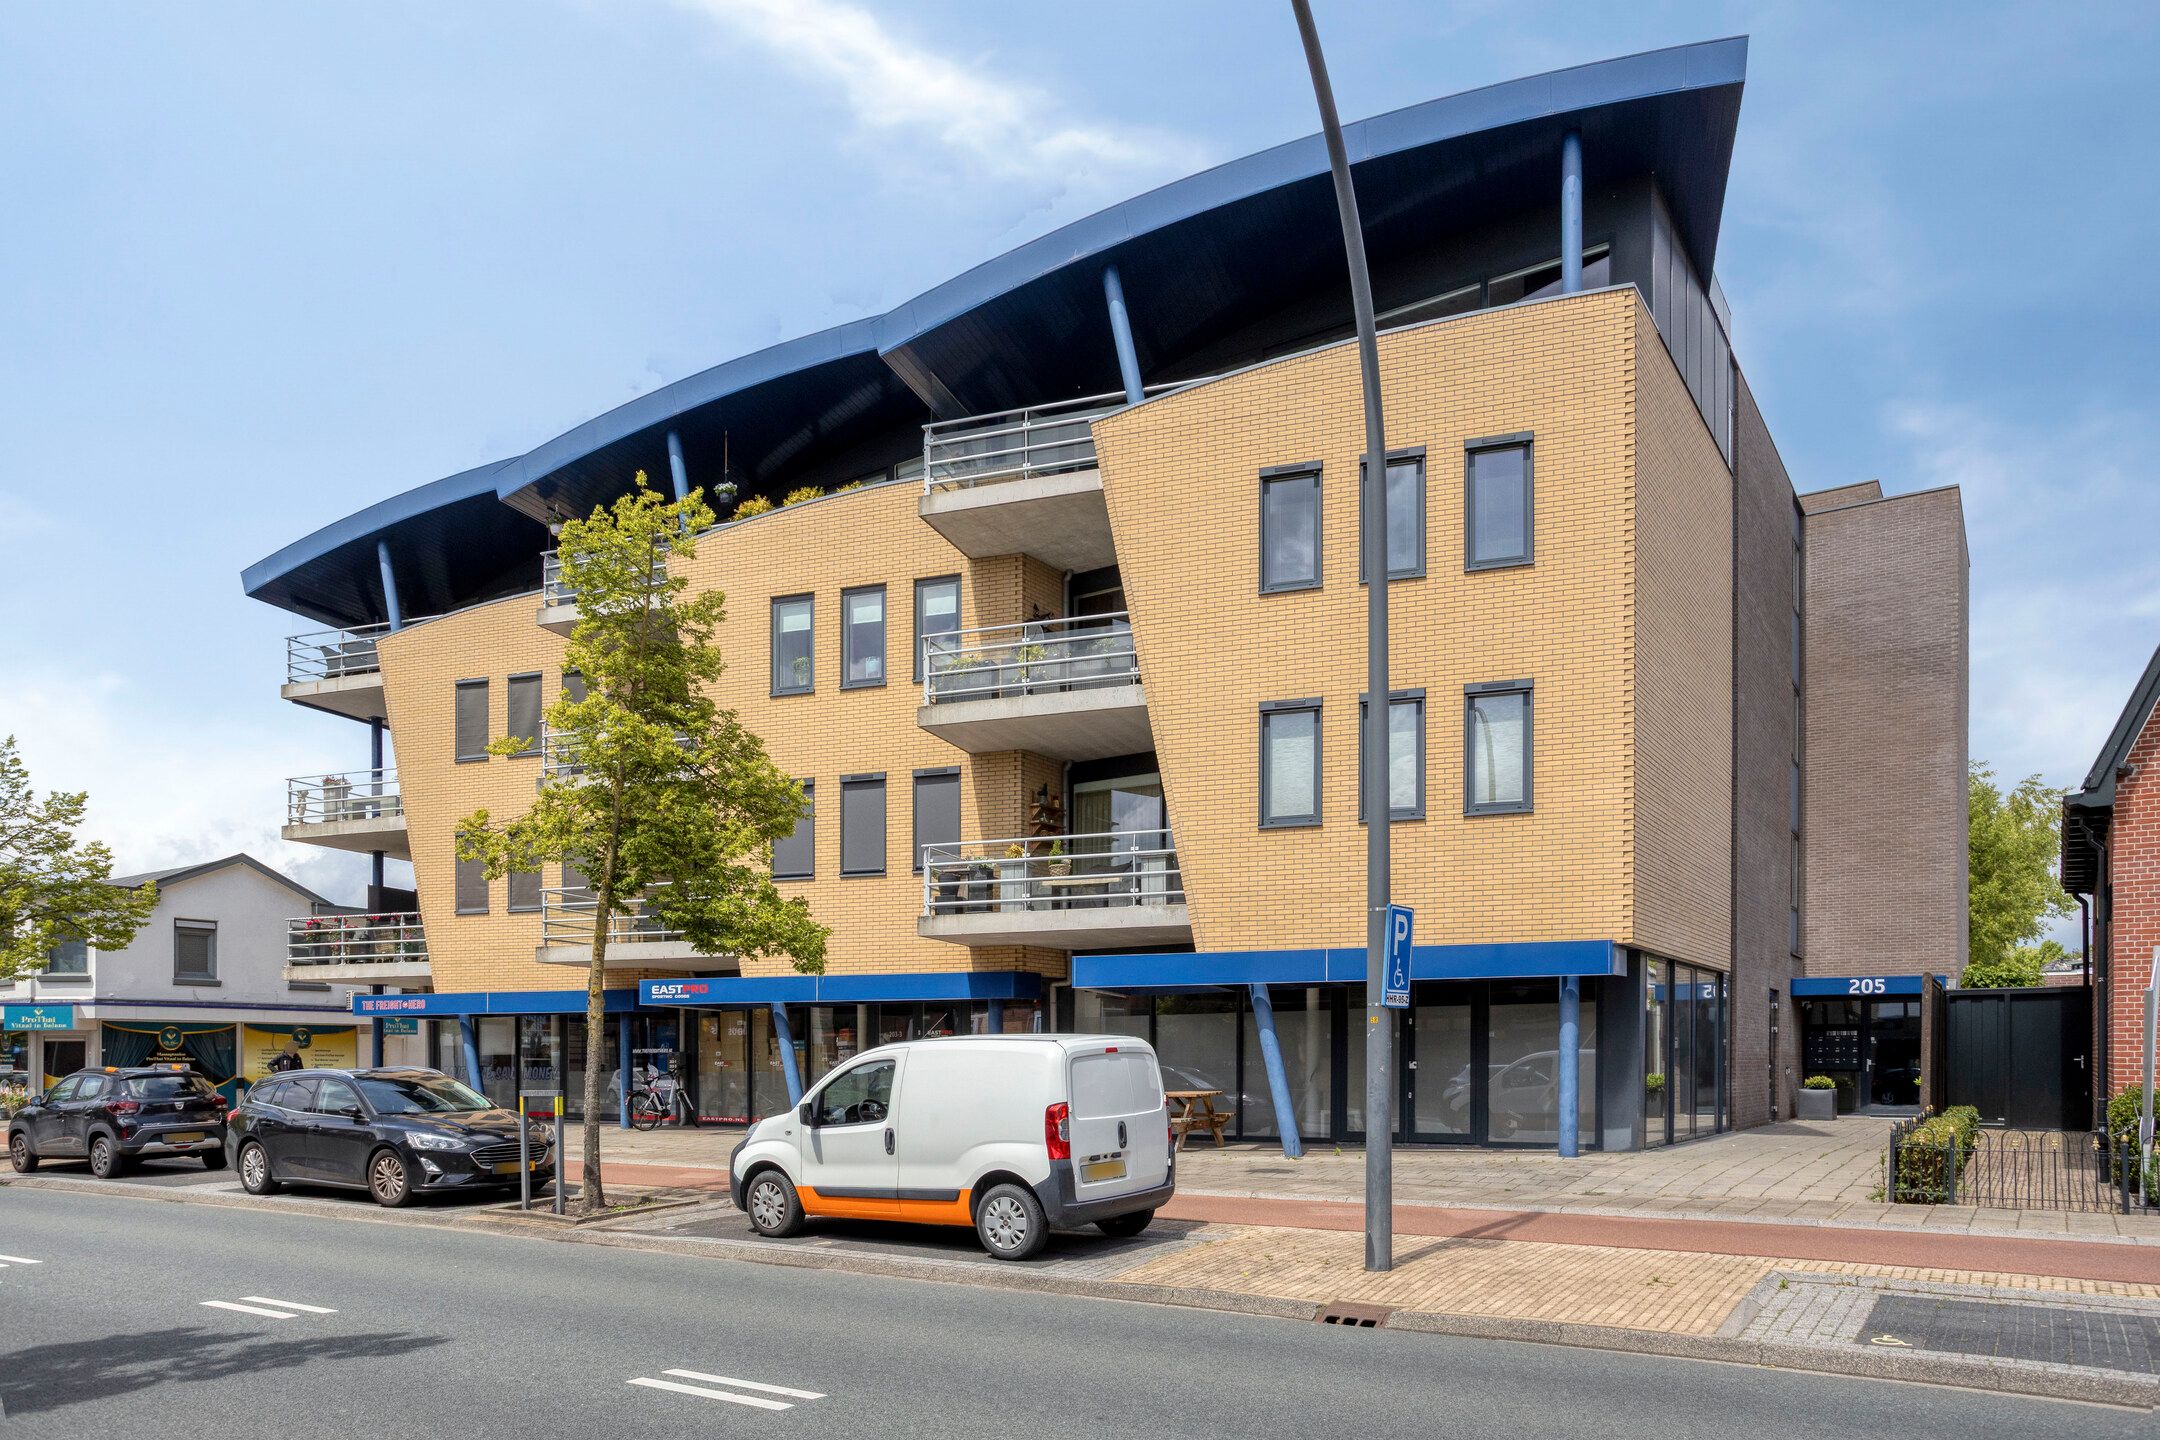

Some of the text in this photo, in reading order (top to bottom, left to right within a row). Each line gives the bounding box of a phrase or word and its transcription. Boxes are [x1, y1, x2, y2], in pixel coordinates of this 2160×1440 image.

[1394, 914, 1408, 955] P
[652, 984, 708, 995] EASTPRO
[1849, 979, 1885, 994] 205
[362, 999, 426, 1010] THE FREIGHT HERO
